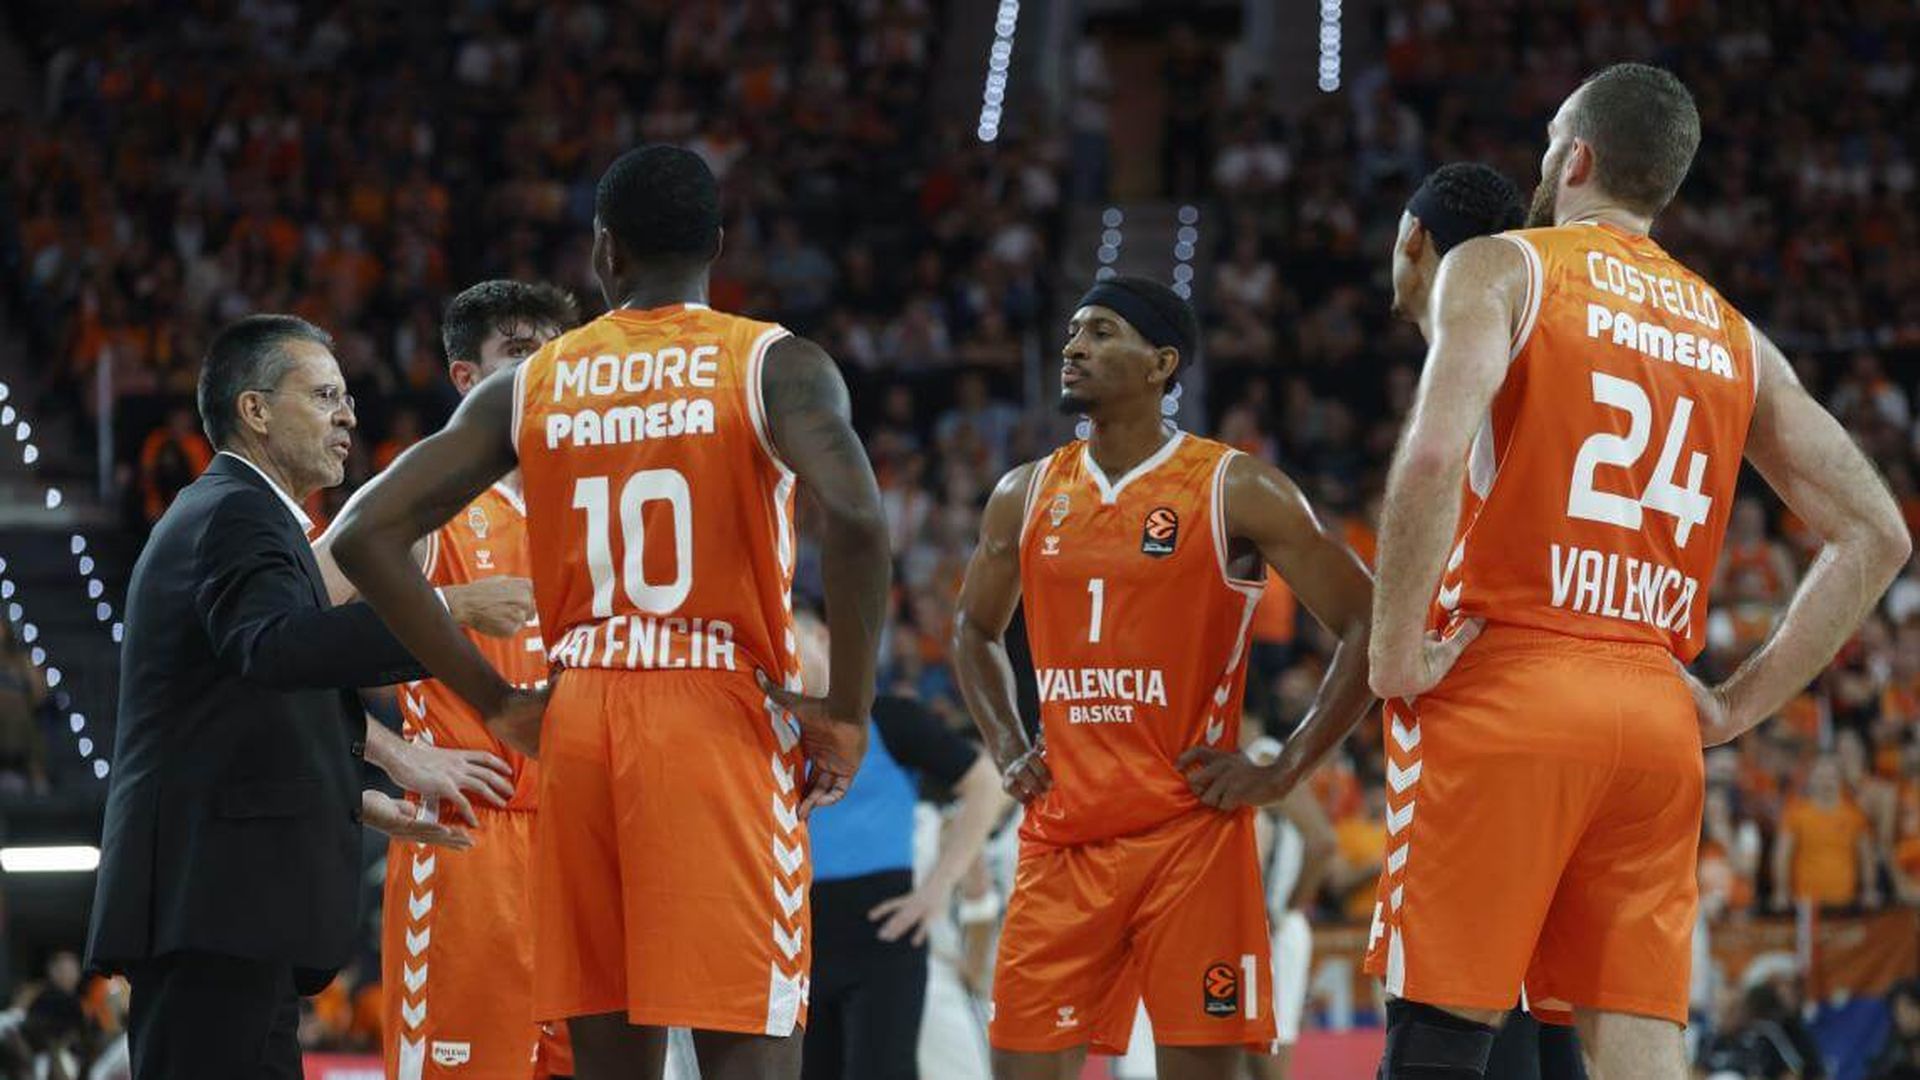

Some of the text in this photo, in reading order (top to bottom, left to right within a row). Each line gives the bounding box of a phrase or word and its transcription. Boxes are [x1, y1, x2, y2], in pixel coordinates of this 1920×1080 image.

[1586, 252, 1720, 330] COSTELLO
[1587, 303, 1734, 379] PAMESA
[553, 346, 719, 402] MOORE
[546, 399, 714, 449] PAMESA
[1566, 371, 1713, 549] 24
[572, 468, 693, 618] 10
[1087, 578, 1104, 643] 1
[1035, 669, 1168, 706] VALENCIA
[1069, 706, 1134, 724] BASKET
[1241, 954, 1257, 1020] 1
